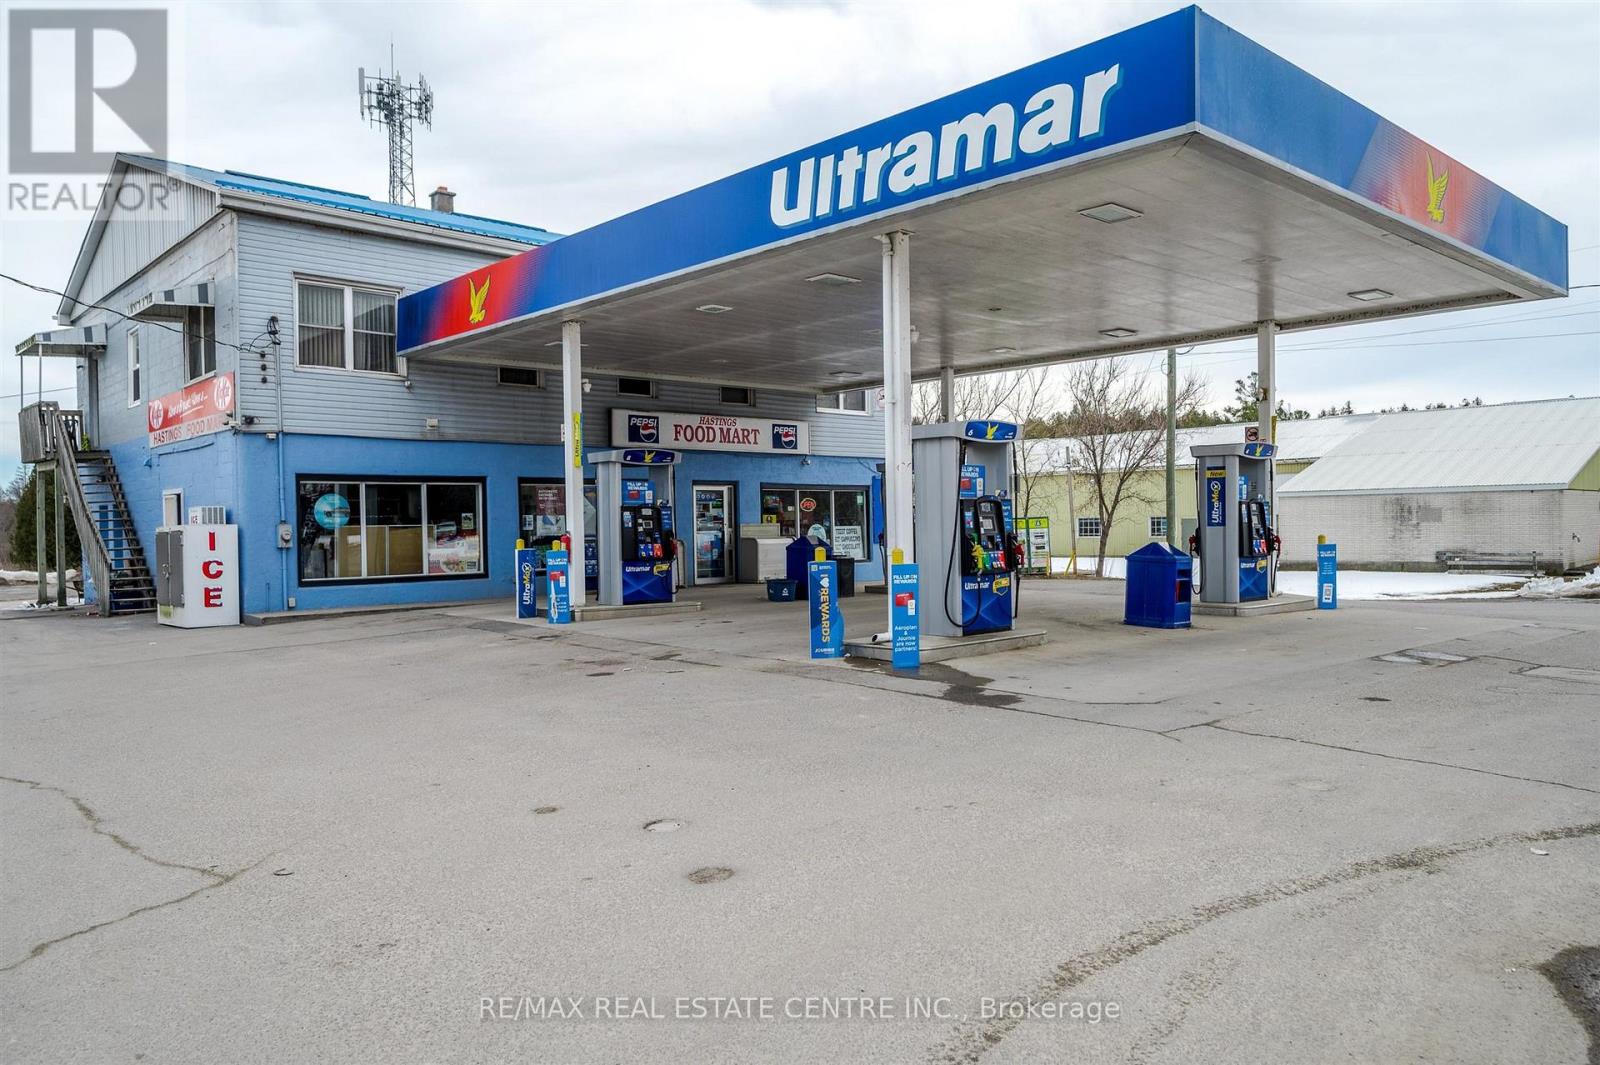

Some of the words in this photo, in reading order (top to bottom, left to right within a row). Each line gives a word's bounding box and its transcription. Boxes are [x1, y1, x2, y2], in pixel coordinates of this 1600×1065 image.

[769, 62, 1121, 228] Ultramar
[630, 417, 657, 427] PEPSI
[699, 416, 737, 427] HASTINGS
[773, 427, 796, 435] PEPSI
[153, 426, 183, 446] HASTINGS
[673, 424, 716, 443] FOOD
[719, 427, 760, 445] MART
[202, 531, 224, 608] ICE
[521, 563, 532, 605] UltraMax
[819, 588, 830, 643] REWARDS
